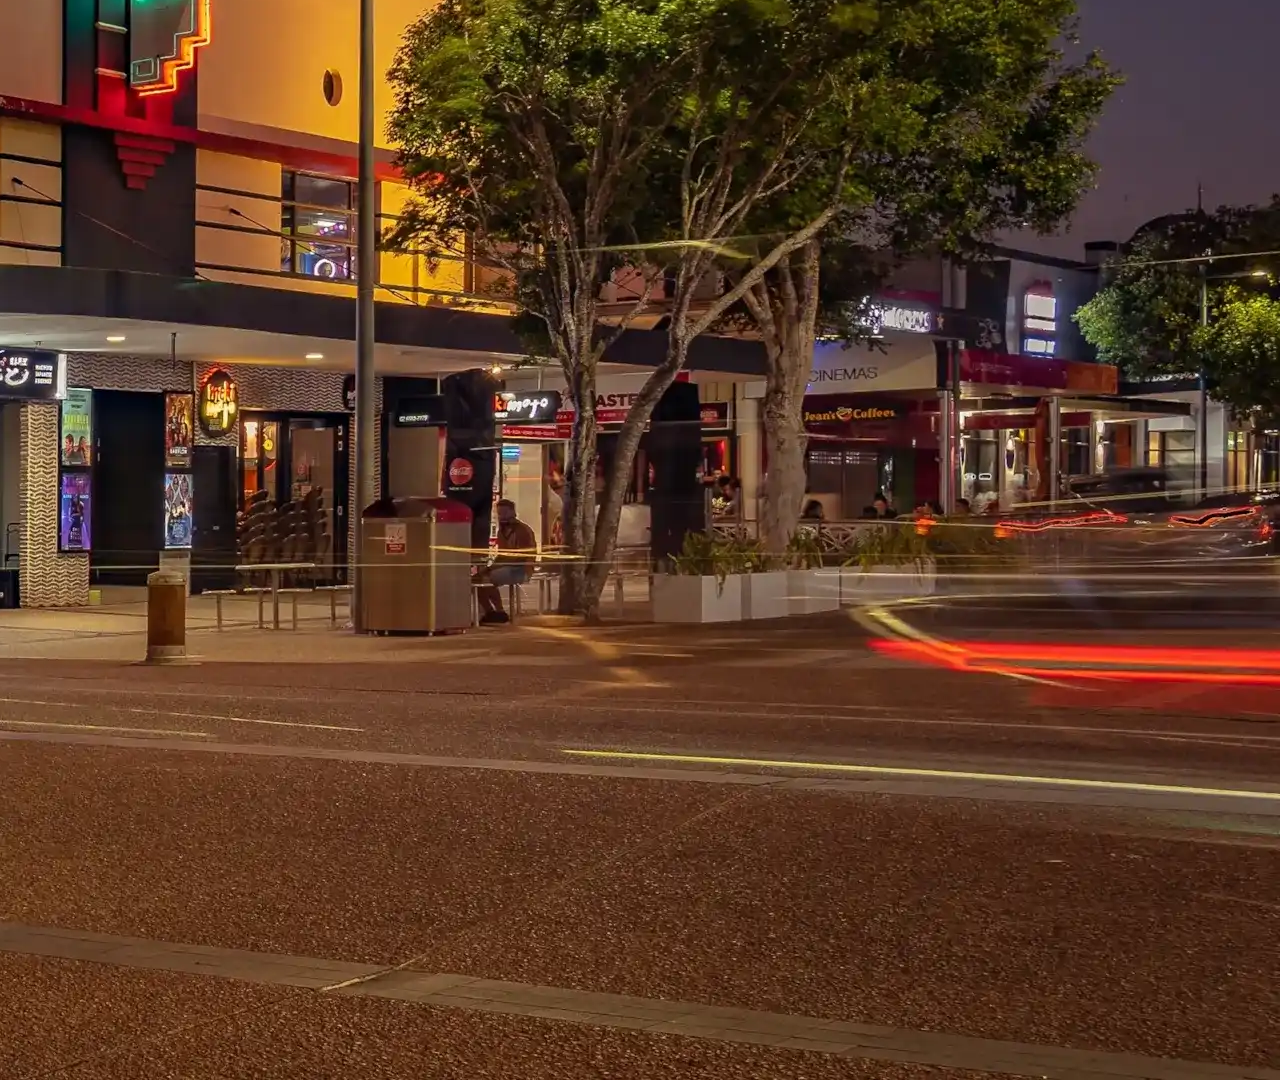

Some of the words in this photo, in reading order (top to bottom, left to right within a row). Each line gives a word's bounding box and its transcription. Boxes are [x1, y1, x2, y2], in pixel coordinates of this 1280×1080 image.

[808, 367, 878, 383] CINEMAS
[596, 393, 637, 407] ASTE
[852, 408, 895, 419] Coffees
